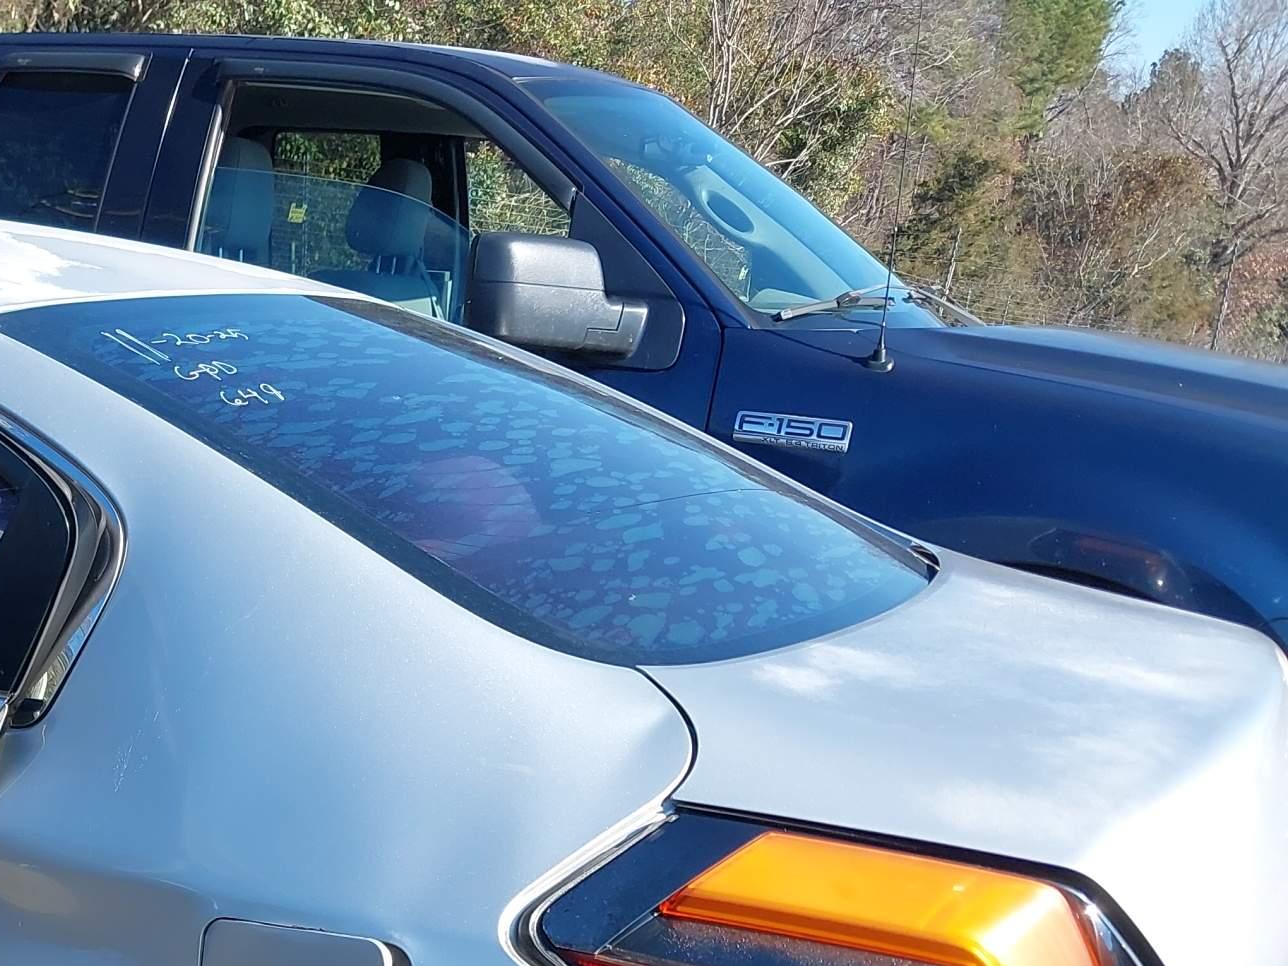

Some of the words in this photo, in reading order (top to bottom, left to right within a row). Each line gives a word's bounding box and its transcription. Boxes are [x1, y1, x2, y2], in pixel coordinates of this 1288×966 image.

[100, 328, 249, 365] 11-20-25
[174, 360, 238, 381] GPD
[737, 413, 849, 442] F-150
[806, 439, 845, 452] TRITON
